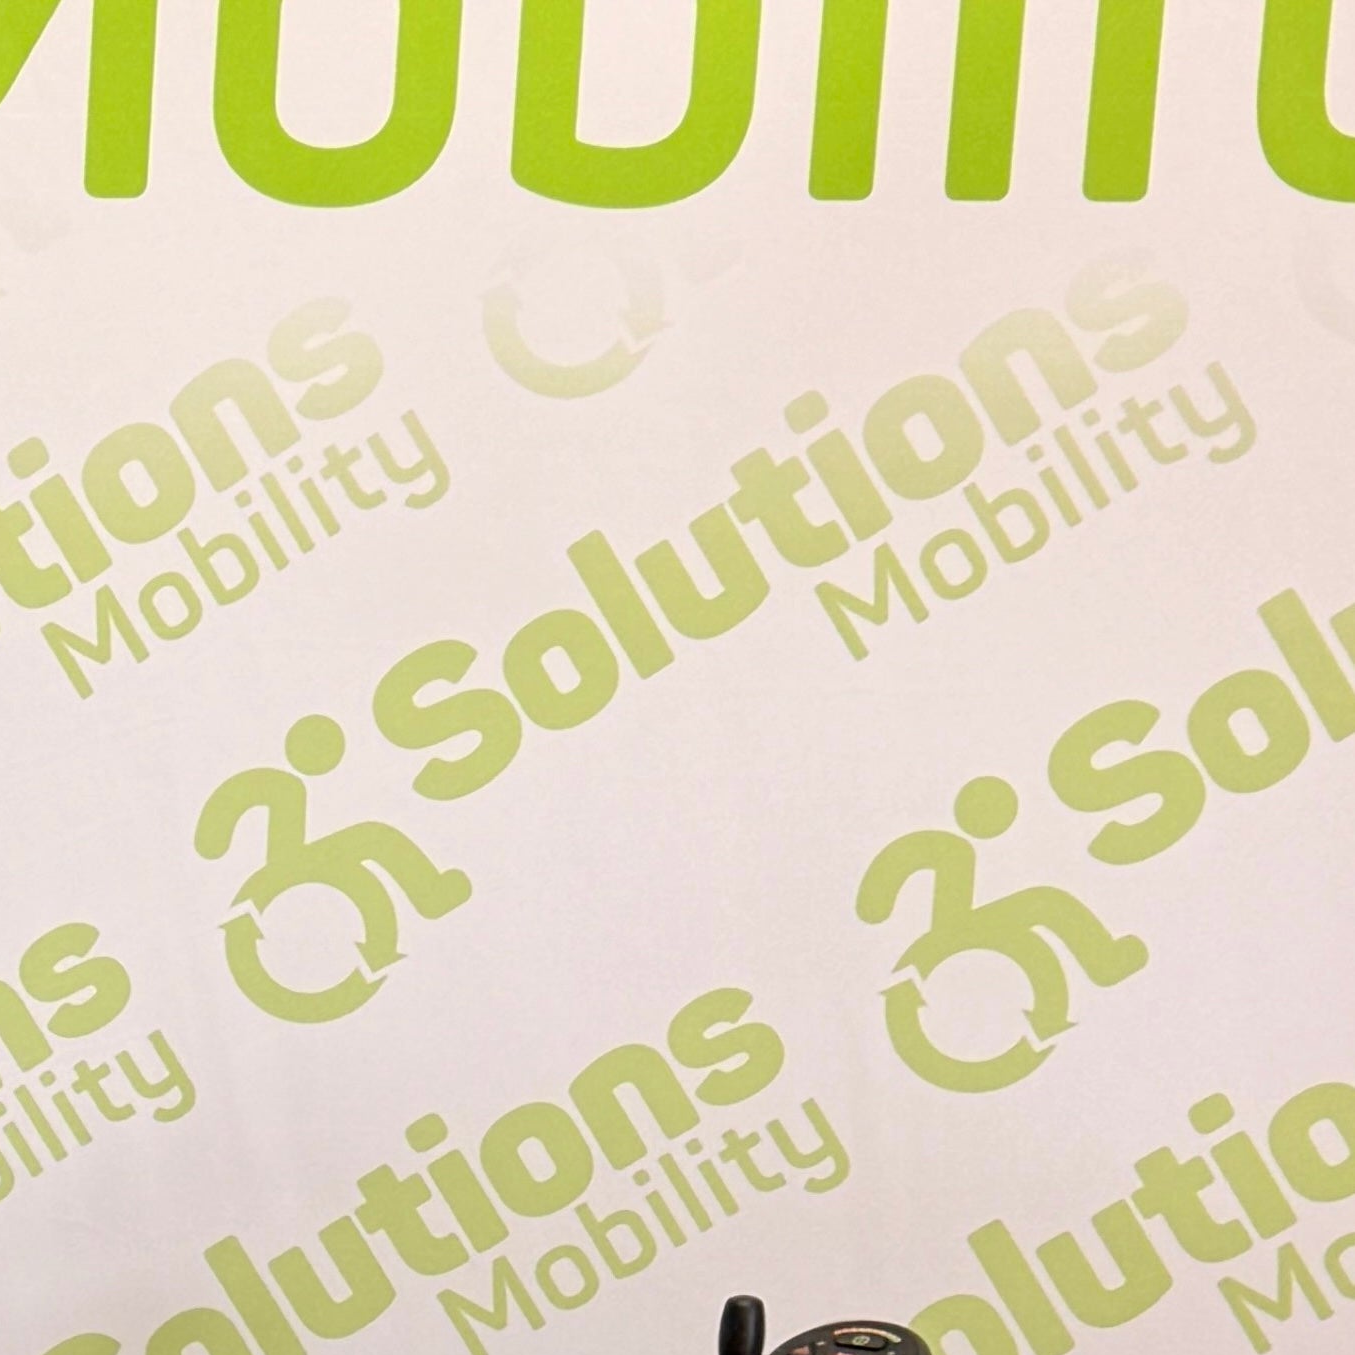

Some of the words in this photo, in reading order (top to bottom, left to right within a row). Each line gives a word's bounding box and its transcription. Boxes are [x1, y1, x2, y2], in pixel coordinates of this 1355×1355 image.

[40, 410, 450, 700] Mobility
[371, 249, 1191, 801] Solutions
[814, 361, 1258, 662] Mobility
